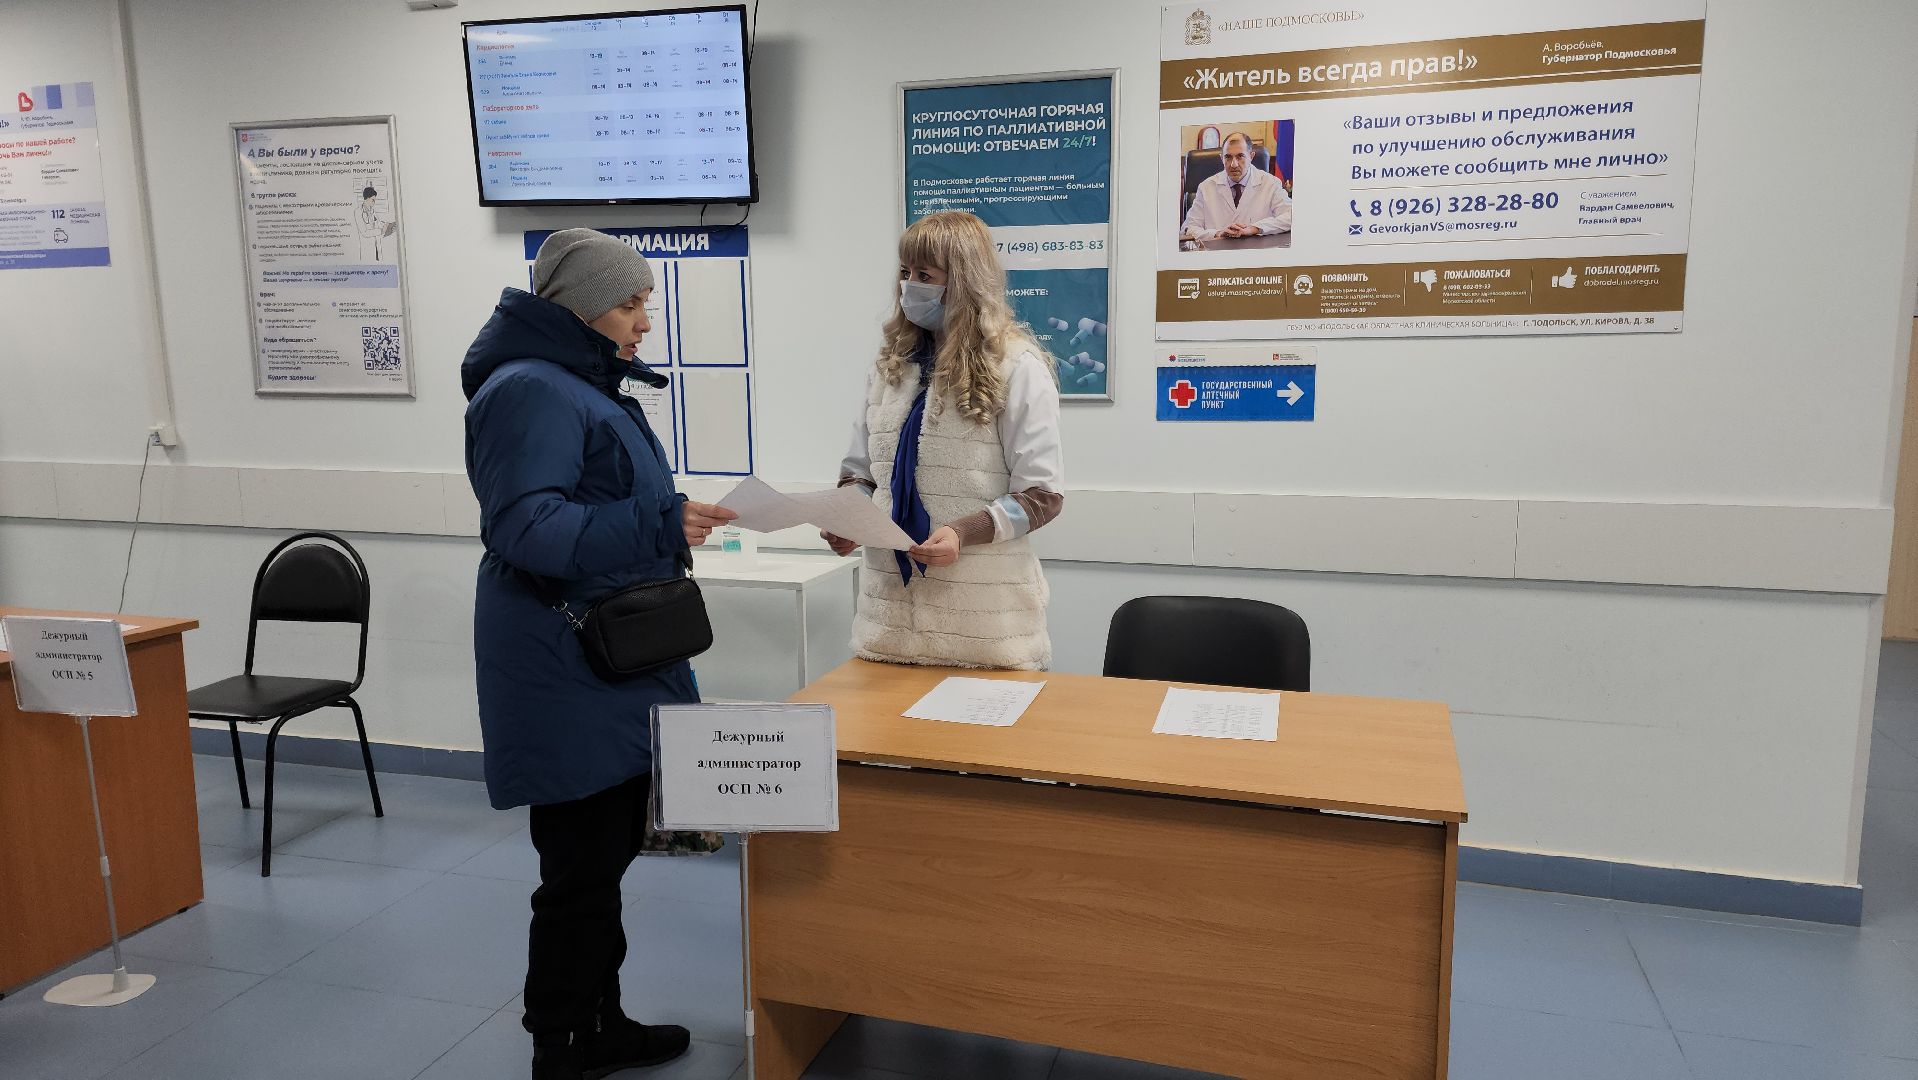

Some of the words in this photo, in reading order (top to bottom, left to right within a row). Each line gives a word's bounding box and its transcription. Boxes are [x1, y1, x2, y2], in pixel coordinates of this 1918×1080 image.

[1218, 18, 1263, 32] «НАШЕ
[1266, 10, 1365, 28] ПОДМОСКОВЬЕ»
[1543, 43, 1553, 52] А.
[1542, 52, 1602, 66] Губернатор
[1604, 46, 1677, 59] Подмосковья
[1183, 66, 1291, 90] «Житель
[1298, 60, 1382, 83] всегда
[1391, 49, 1478, 81] прав!»
[912, 105, 1037, 124] КРУГЛОСУТОЧНАЯ
[1040, 102, 1104, 117] ГОРЯЧАЯ
[1343, 115, 1400, 130] «Ваши
[1405, 111, 1476, 127] отзывы
[1482, 110, 1493, 121] и
[1498, 101, 1633, 123] предложения
[911, 127, 960, 140] ЛИНИЯ
[963, 125, 984, 137] ПО
[987, 117, 1106, 136] ПАЛЛИАТИВНОЙ
[912, 141, 981, 155] ПОМОЩИ:
[983, 138, 1059, 152] ОТВЕЧАЕМ
[1063, 135, 1097, 149] 24/7!
[1352, 143, 1374, 154] по
[1379, 137, 1486, 157] улучшению
[1492, 128, 1635, 149] обслуживания
[247, 148, 256, 158] А
[258, 148, 274, 158] Вы
[277, 147, 308, 157] были
[310, 149, 317, 158] у
[320, 144, 361, 157] врача?
[1351, 165, 1376, 180] Вы
[1381, 164, 1450, 178] можете
[1454, 157, 1548, 175] сообщить
[1554, 156, 1591, 169] мне
[1595, 152, 1668, 167] лично»
[920, 178, 973, 187] Подмосковье
[976, 176, 1012, 185] работает
[1014, 176, 1047, 184] горячая
[914, 189, 945, 197] помощи
[947, 186, 1006, 195] паллиативным
[1009, 185, 1054, 194] пациентам
[1066, 182, 1105, 190] больным
[984, 194, 1068, 204] прогрессирующими
[1370, 200, 1382, 216] 8
[1388, 197, 1441, 218] (926)
[1448, 192, 1559, 213] 328-28-80
[1580, 203, 1613, 213] Вардан
[1615, 201, 1675, 211] Самвелович,
[51, 209, 66, 219] 112
[1578, 216, 1617, 225] Главный
[1619, 216, 1642, 225] врач
[1369, 220, 1517, 235] GevorkjanVS@mosreg.ru
[619, 233, 710, 255] РМАЦИЯ
[1007, 242, 1038, 254] (498)
[1042, 240, 1104, 251] 683-83-83
[1444, 269, 1511, 280] ПОЖАЛОВАТЬСЯ
[1584, 264, 1660, 275] ПОБЛАГОДАРИТЬ
[1207, 276, 1254, 287] ЗАПИСАТЬСЯ
[1255, 275, 1283, 285] ONLINE
[1321, 273, 1368, 283] ПОЗВОНИТЬ
[1201, 379, 1273, 390] ГОСУДАРСТВЕННЫЙ
[1201, 390, 1240, 400] АПТЕЧНЫЙ
[1201, 400, 1224, 409] ПУНКТ
[41, 630, 88, 642] Дежурный
[35, 651, 102, 663] администратор
[52, 669, 74, 679] ОСП
[76, 671, 86, 680] №
[87, 671, 94, 680] 5
[712, 730, 785, 745] Дежурный
[697, 759, 801, 772] администратор
[718, 783, 750, 795] ОСП
[756, 783, 771, 795] №
[775, 783, 782, 795] 6
